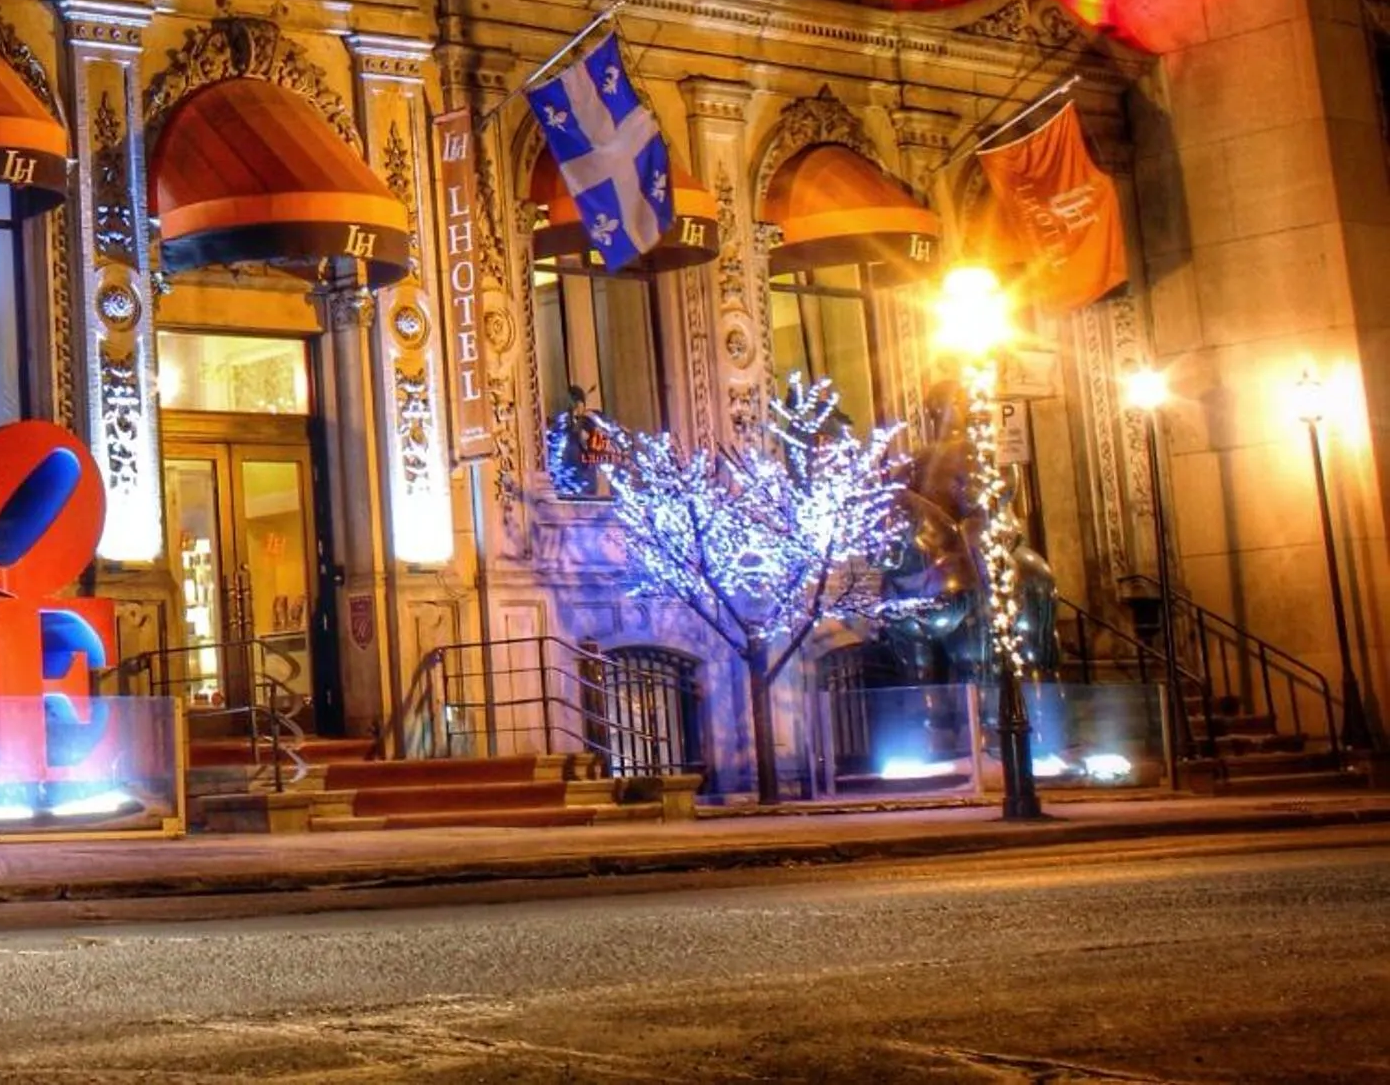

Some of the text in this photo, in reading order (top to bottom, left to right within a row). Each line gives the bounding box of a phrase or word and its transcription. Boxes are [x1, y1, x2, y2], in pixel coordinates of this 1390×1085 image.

[1, 150, 38, 184] LH
[344, 224, 378, 258] LH
[447, 185, 482, 402] LHOTEL
